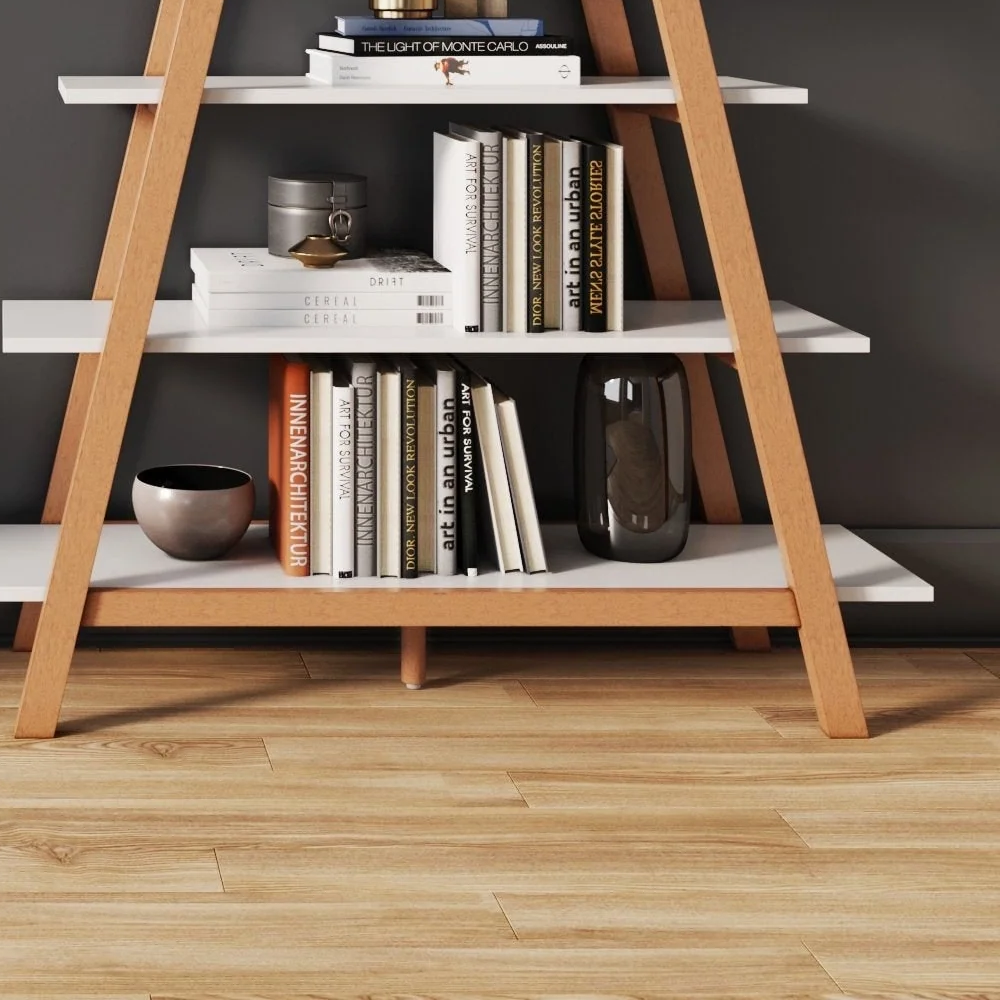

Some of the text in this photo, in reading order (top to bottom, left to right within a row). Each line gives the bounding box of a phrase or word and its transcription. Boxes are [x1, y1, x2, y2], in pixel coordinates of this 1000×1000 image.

[361, 41, 385, 52] THE
[387, 41, 421, 52] LIGHT
[423, 41, 439, 52] OF
[441, 41, 486, 52] MONTE
[487, 41, 529, 52] CARLO
[465, 152, 477, 255] ART FOR SURVIVAL
[482, 144, 500, 305] INNENARCHITEKTUR
[532, 144, 543, 222] REVOLUTION
[532, 226, 543, 259] LOOK
[532, 263, 543, 290] NEW
[564, 167, 580, 308] art in an urban
[304, 296, 358, 306] CEREAL
[304, 313, 358, 324] CEREAL
[339, 398, 351, 500] ART FOR SURVIVAL
[356, 375, 374, 546] INNENARCHITEKTUR
[406, 379, 416, 462] REVOLUTION
[461, 383, 474, 493] ART FOR SURVIVAL
[289, 394, 308, 567] INNENARCHITEKTUR
[406, 465, 416, 500] LOOK
[438, 398, 455, 551] art in an urban
[406, 503, 416, 533] NEW
